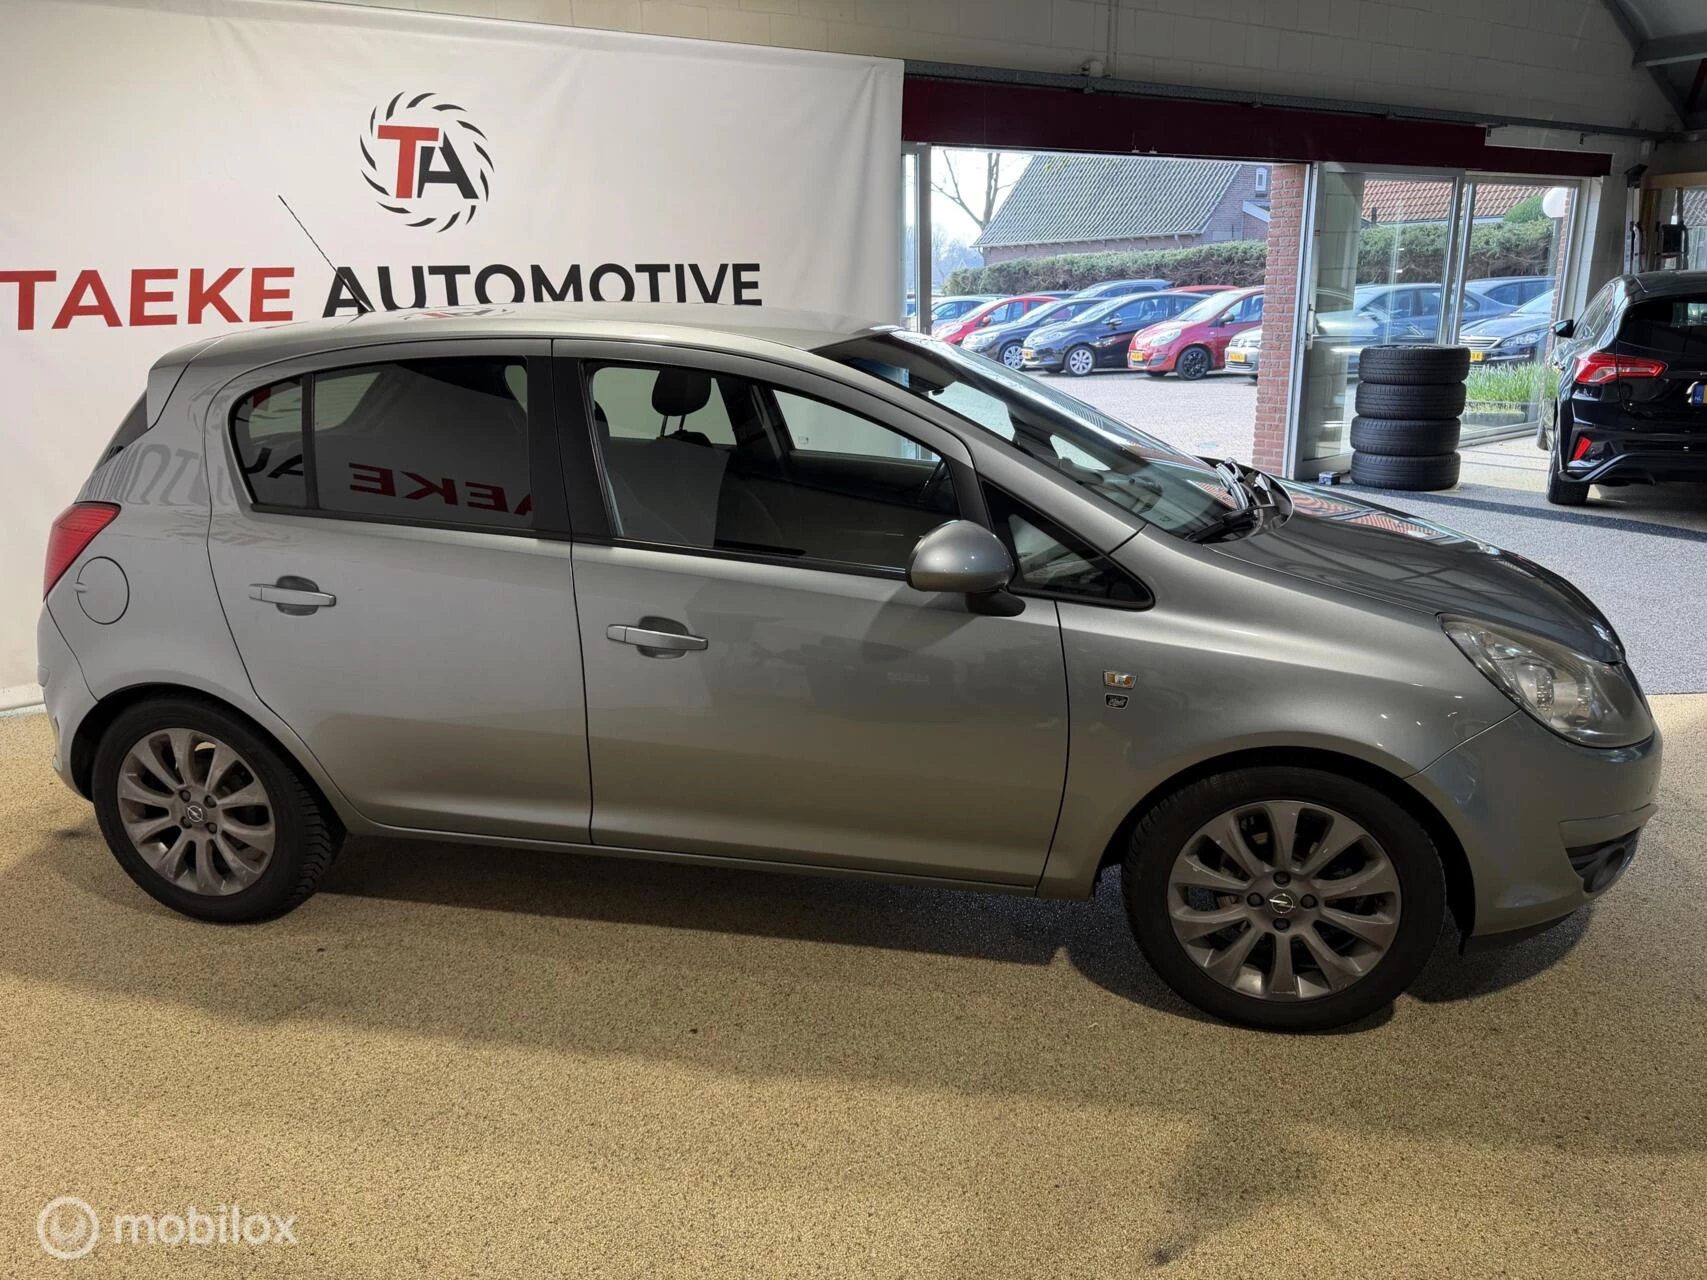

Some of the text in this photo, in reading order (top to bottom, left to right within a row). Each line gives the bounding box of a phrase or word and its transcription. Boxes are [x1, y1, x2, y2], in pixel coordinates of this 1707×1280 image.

[377, 124, 479, 199] TA
[0, 263, 762, 330] TAEKE AUTOMOTIVE
